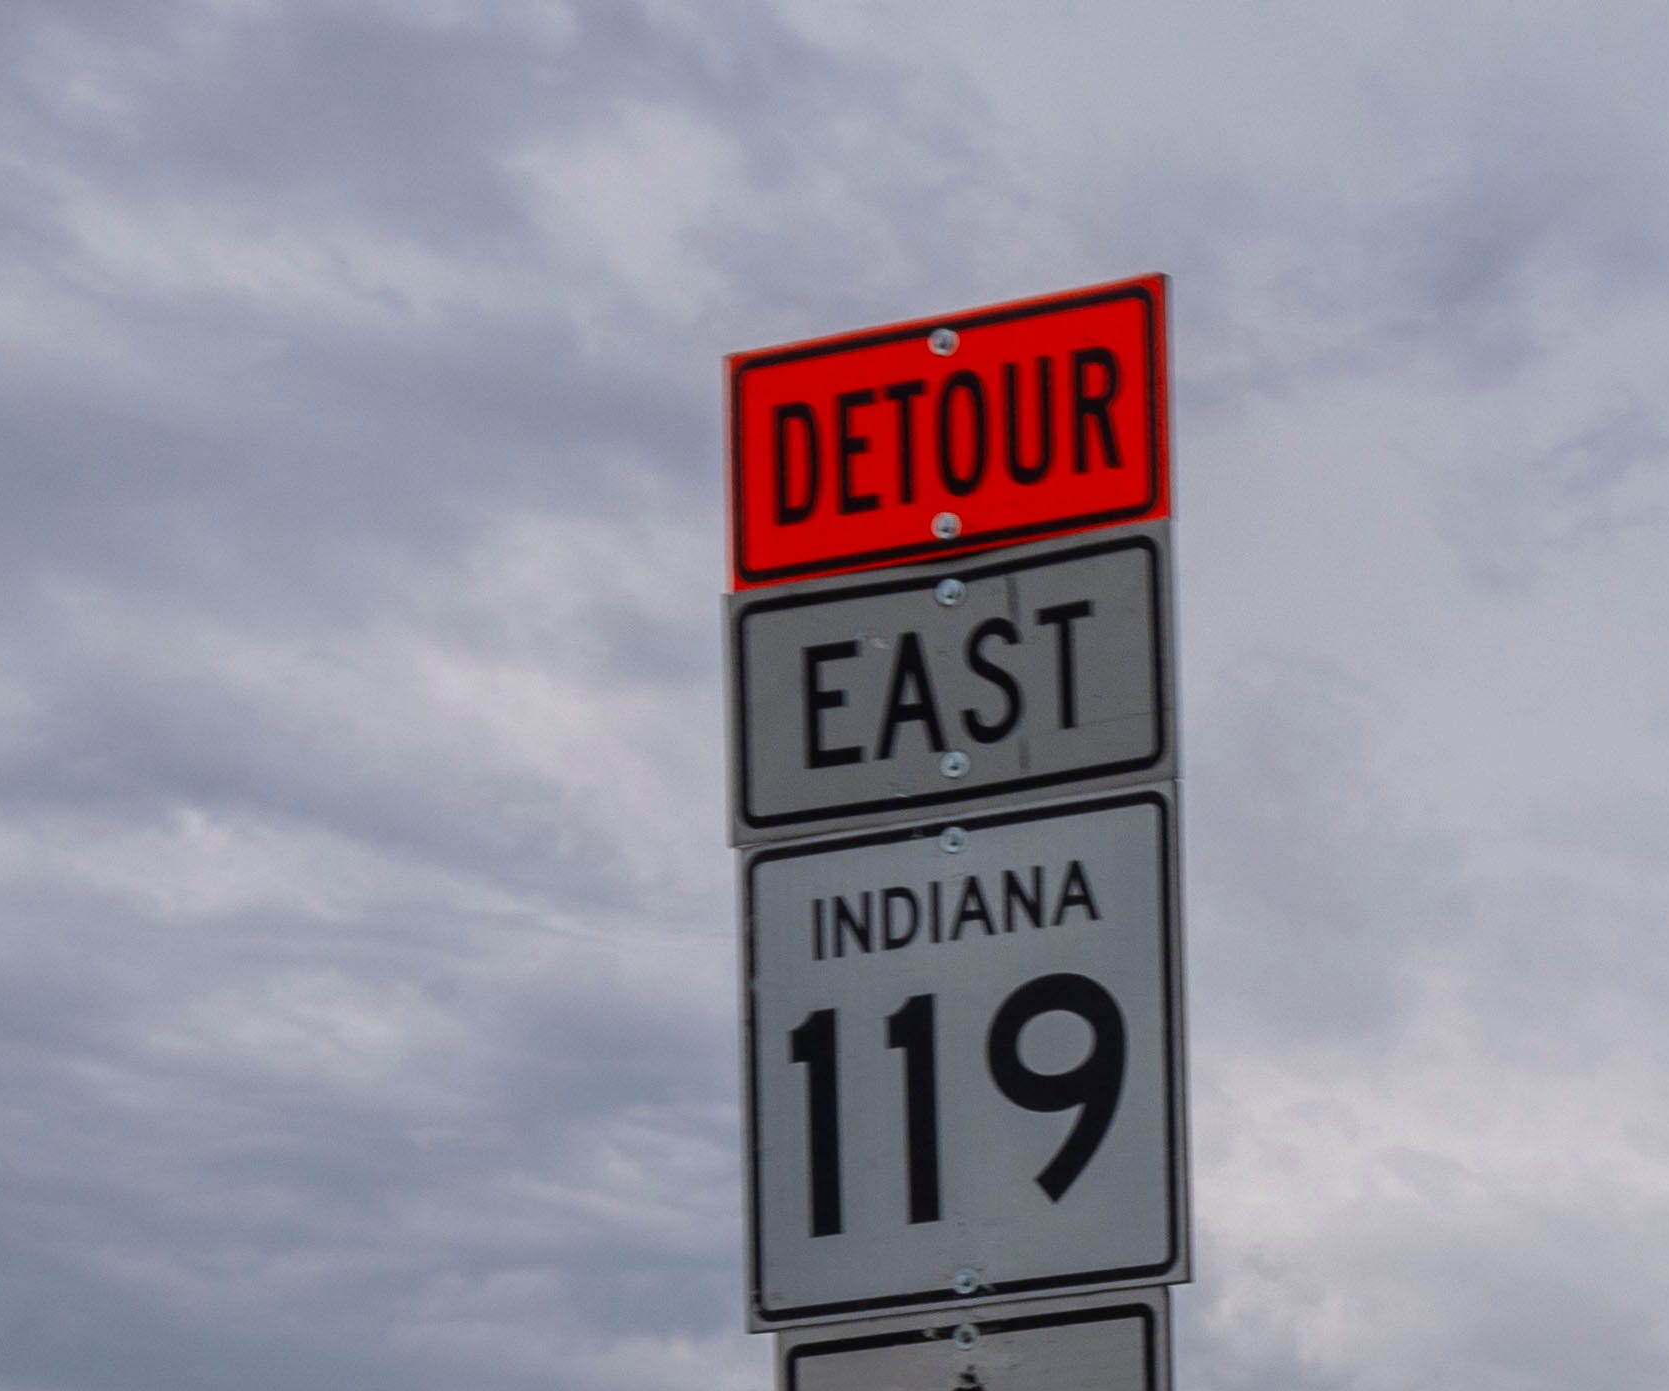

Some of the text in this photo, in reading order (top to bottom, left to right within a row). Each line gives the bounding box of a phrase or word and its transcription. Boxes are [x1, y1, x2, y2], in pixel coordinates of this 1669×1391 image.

[771, 346, 1124, 527] DETOUR
[801, 600, 1094, 769] EAST
[810, 859, 1102, 961] INDIANA
[788, 971, 1127, 1239] 119
